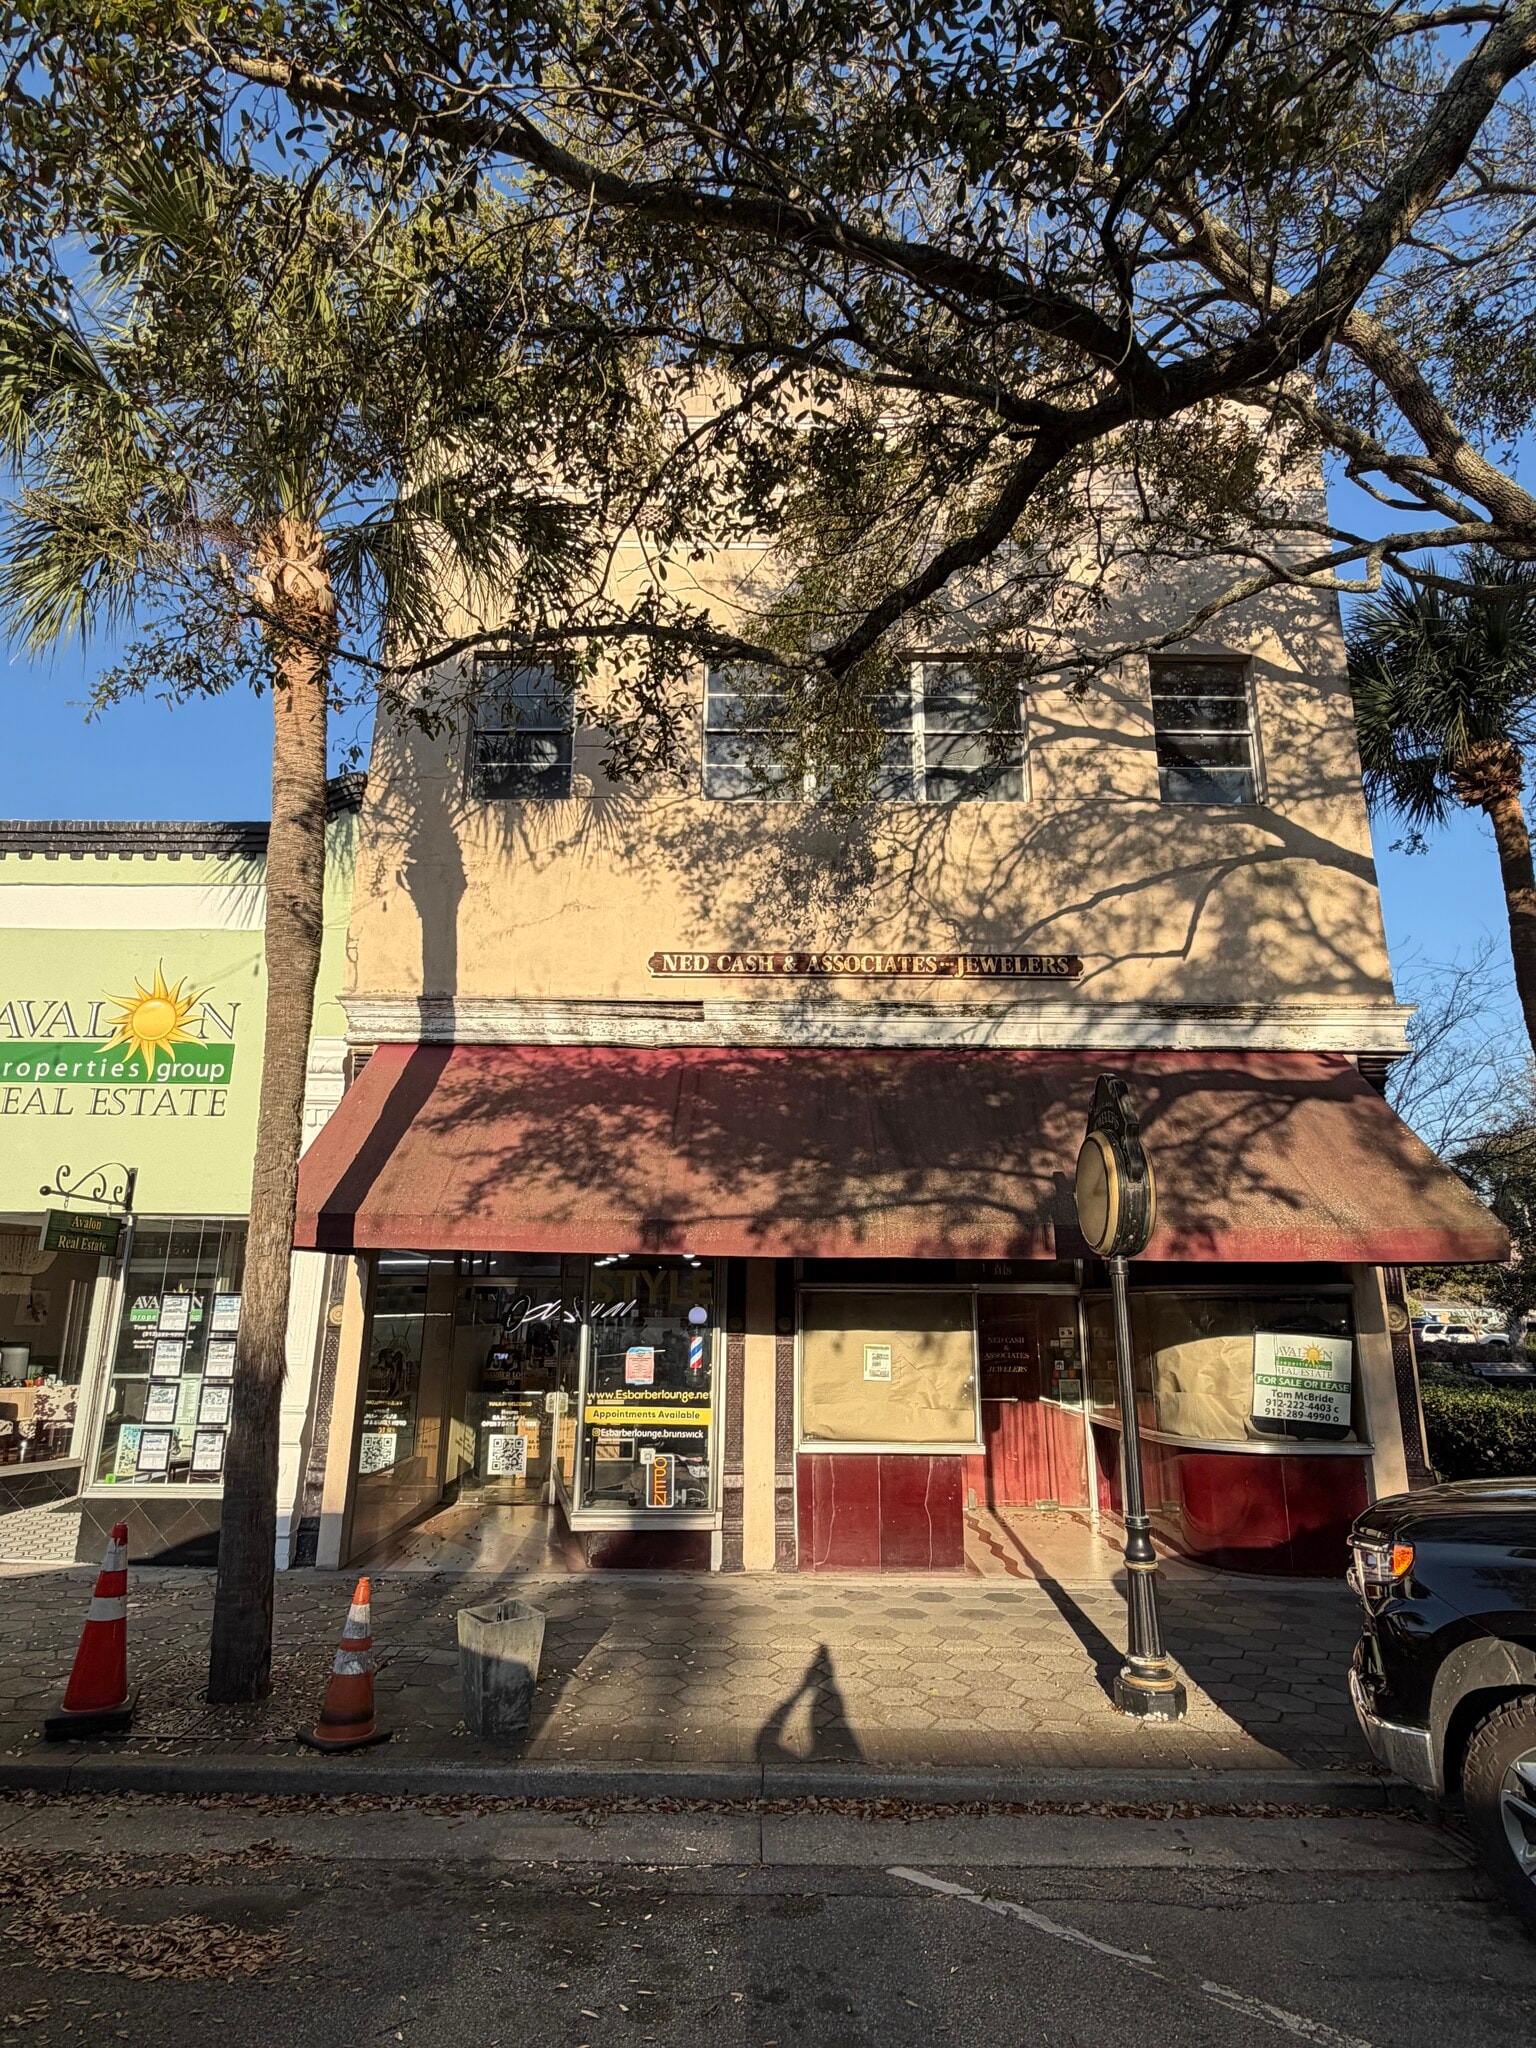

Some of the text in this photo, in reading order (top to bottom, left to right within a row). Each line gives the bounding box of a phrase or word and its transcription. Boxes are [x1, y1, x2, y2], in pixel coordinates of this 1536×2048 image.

[662, 955, 1070, 978] NED CASH & ASSOCIATES JEWELERS
[0, 1058, 225, 1082] roperties group
[0, 1087, 229, 1117] EAL ESTATE
[71, 1215, 102, 1230] Avalon
[57, 1235, 107, 1252] Real Estate
[591, 1268, 714, 1305] STYLE
[1301, 1368, 1333, 1379] ESTATE
[1257, 1375, 1350, 1393] FOR SALE OR LEASE
[1271, 1389, 1334, 1403] Tom McBride
[1265, 1398, 1332, 1412] 912-222-4403
[593, 1410, 701, 1420] Appointments Available
[1264, 1407, 1331, 1421] 912-289-4990
[600, 1428, 704, 1440] Esbarberlounge.brunswick
[654, 1457, 668, 1506] OPEN
